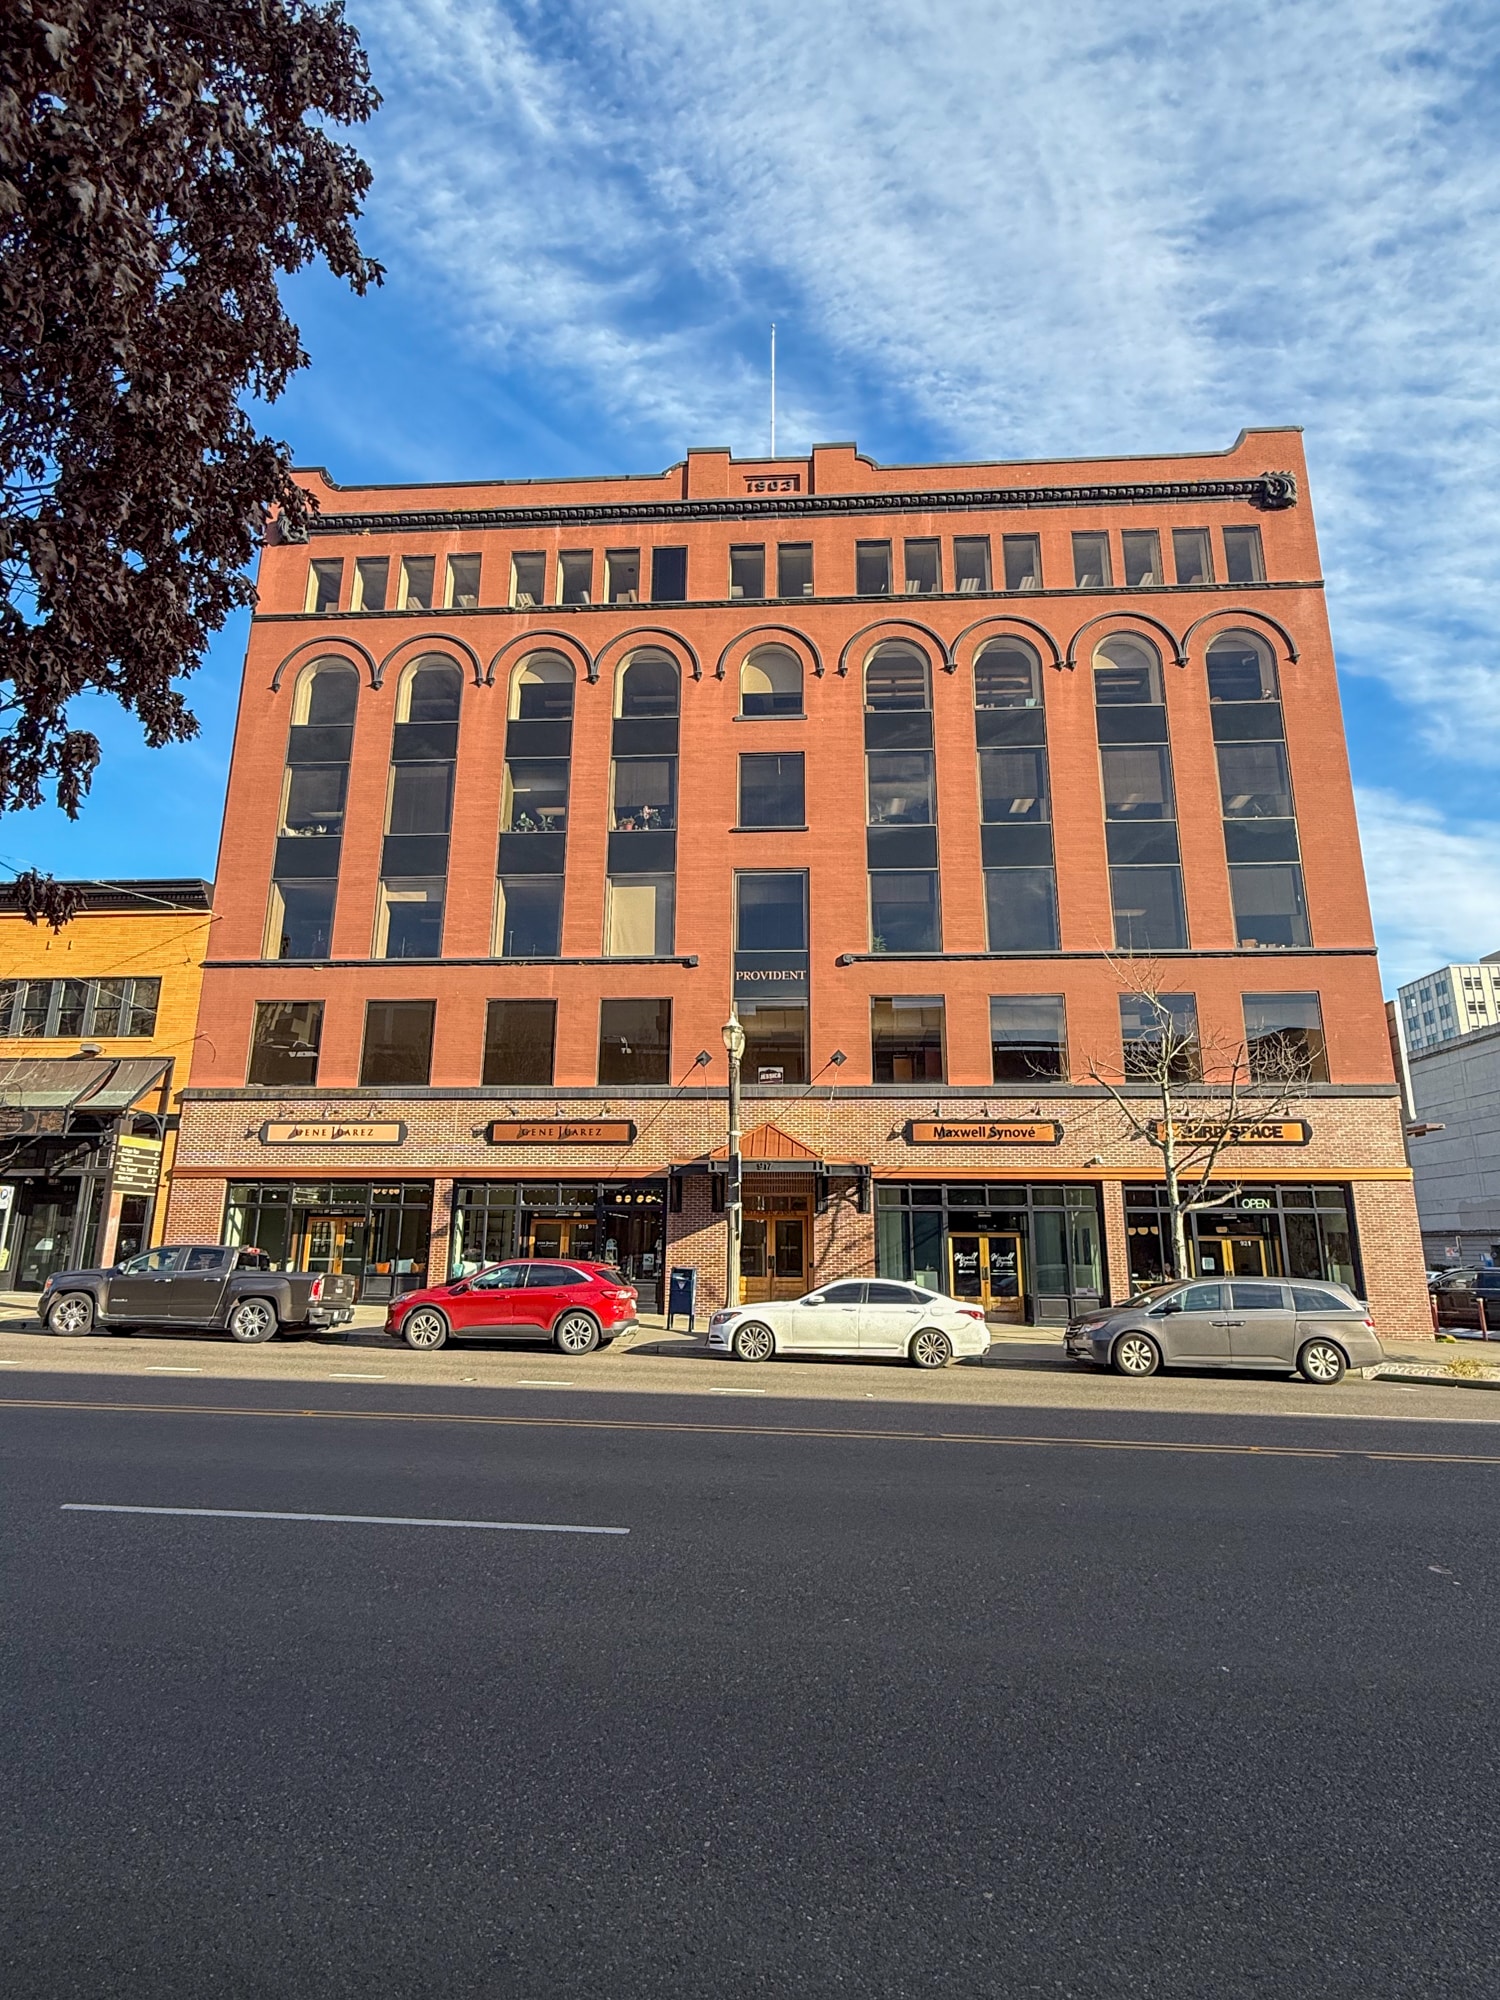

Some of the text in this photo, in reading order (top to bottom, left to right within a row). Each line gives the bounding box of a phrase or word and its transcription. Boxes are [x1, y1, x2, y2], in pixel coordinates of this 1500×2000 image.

[747, 480, 792, 493] 1903
[736, 970, 806, 980] PROVIDENT
[521, 1126, 602, 1139] GENE JUAREZ
[933, 1126, 1036, 1140] Maxwell Synové
[1178, 1125, 1283, 1138] HIRD SPACE
[1241, 1199, 1271, 1209] OPEN
